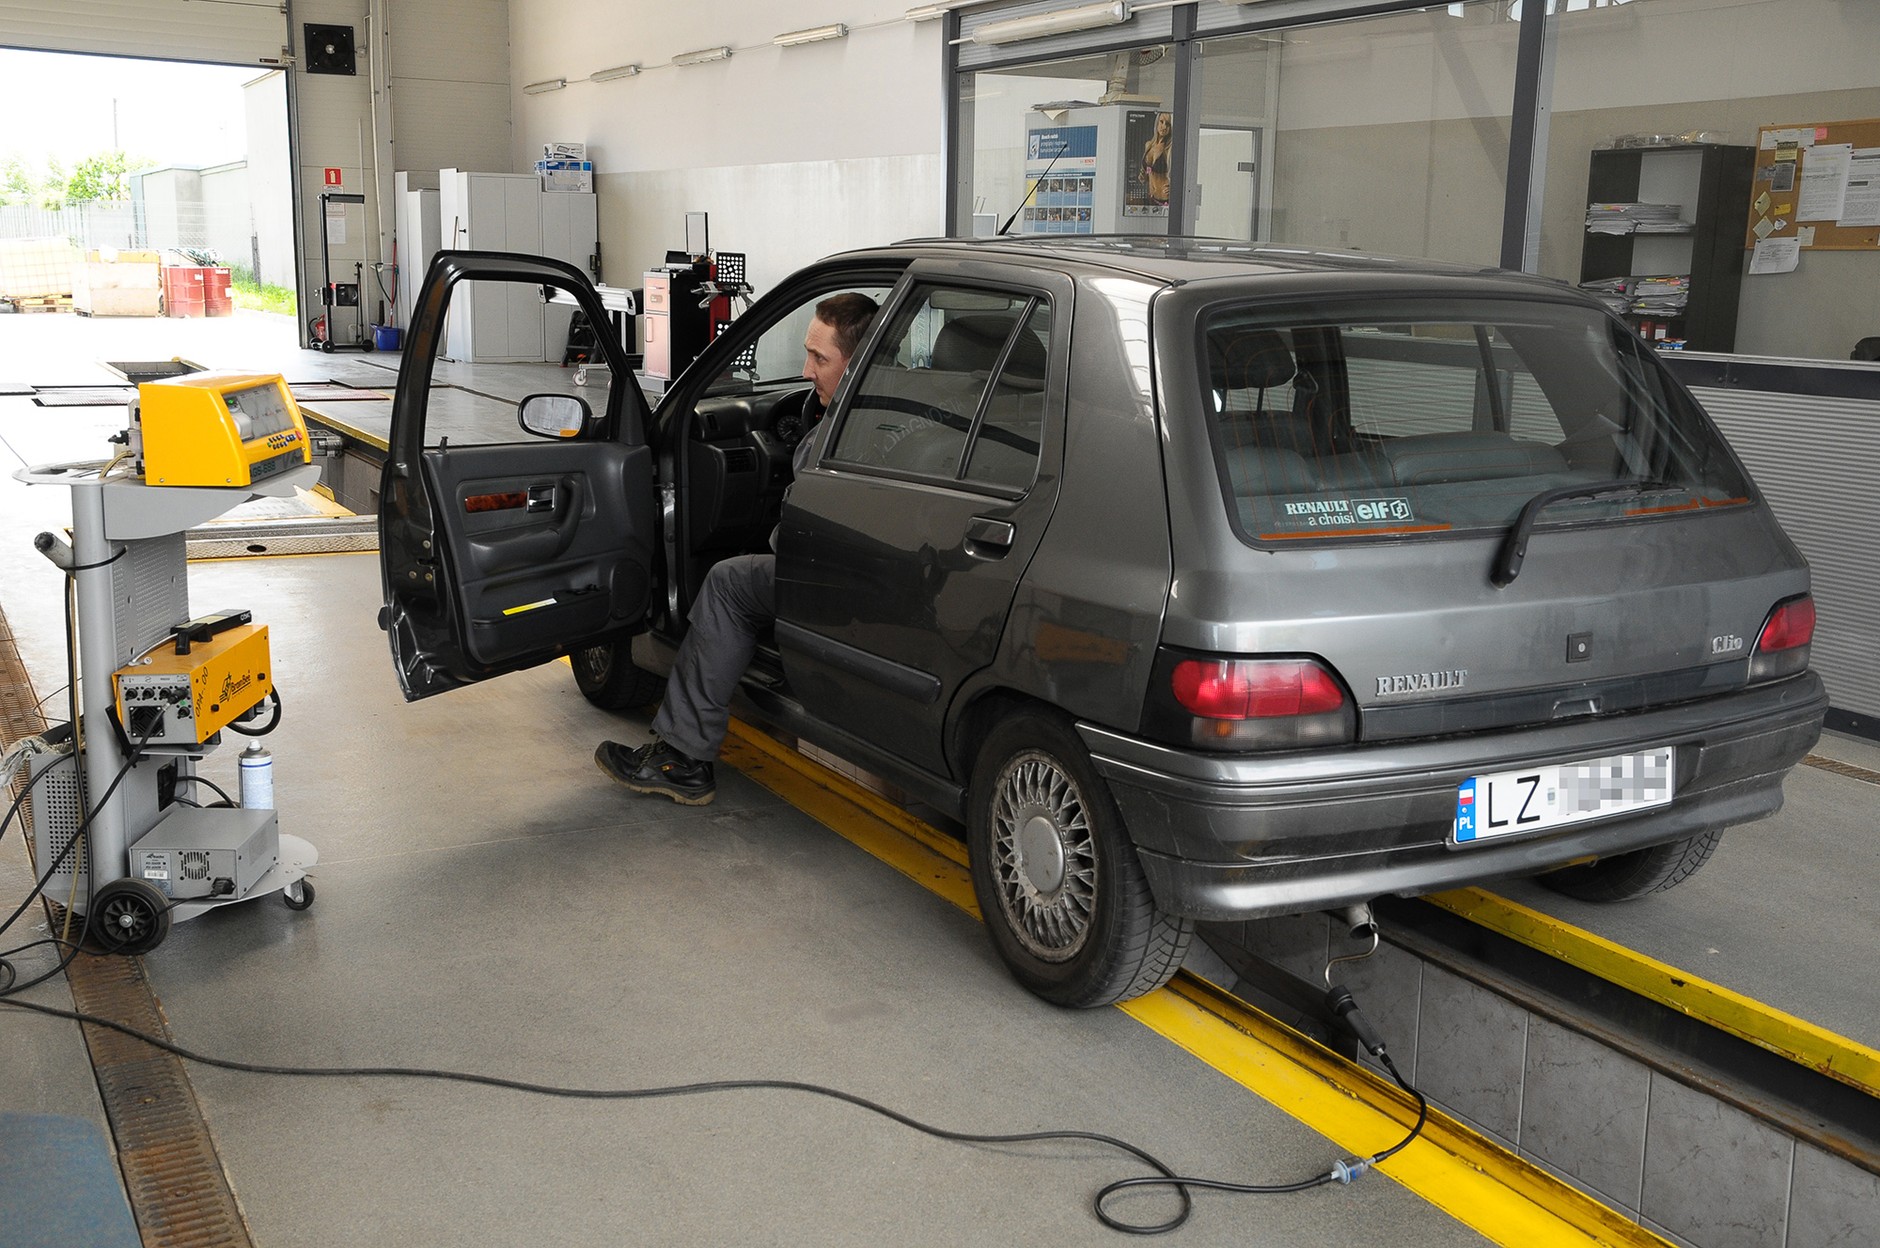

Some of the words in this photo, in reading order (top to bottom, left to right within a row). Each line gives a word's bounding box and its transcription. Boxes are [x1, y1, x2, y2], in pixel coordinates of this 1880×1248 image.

[1285, 500, 1350, 515] RENAULT
[1357, 501, 1390, 520] elf
[1307, 516, 1318, 527] a
[1318, 511, 1356, 526] choisi
[1711, 634, 1743, 654] Clio
[1376, 669, 1468, 697] RENAULT
[1459, 815, 1474, 831] PL
